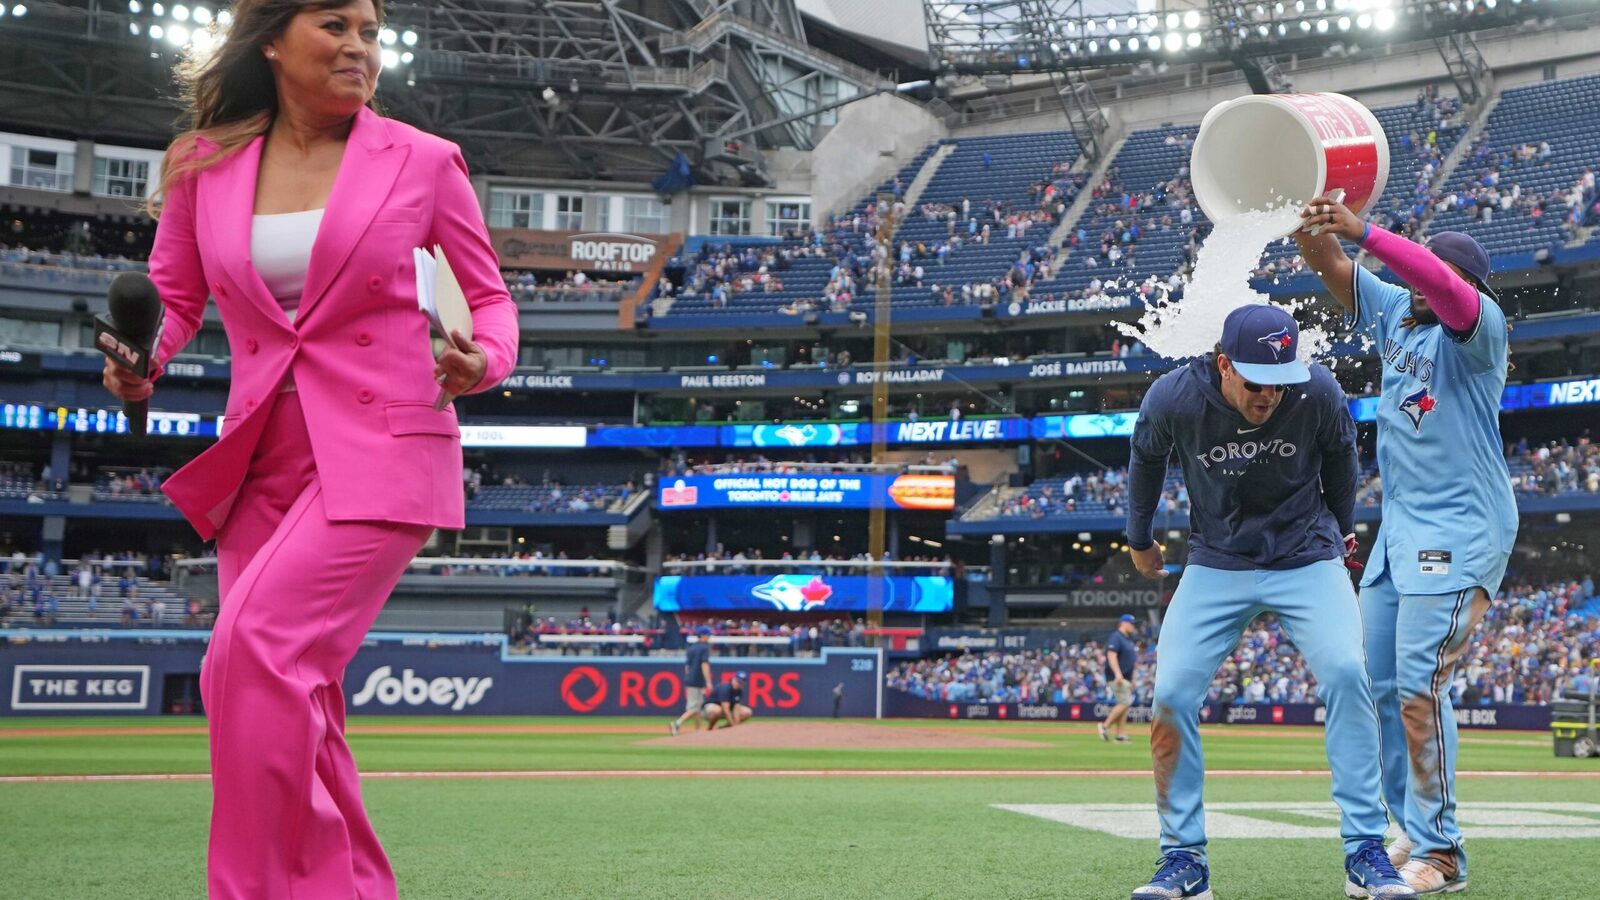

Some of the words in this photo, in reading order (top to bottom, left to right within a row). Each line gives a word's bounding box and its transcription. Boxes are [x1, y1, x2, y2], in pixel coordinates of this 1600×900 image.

[571, 241, 655, 262] ROOFTOP
[594, 261, 632, 271] PATIO
[1025, 300, 1066, 314] JACKIE
[99, 332, 139, 364] SN
[167, 363, 204, 376] STIEB
[856, 372, 880, 384] ROY
[883, 369, 944, 382] HALLADAY
[1029, 361, 1061, 377] JOSÉ
[1066, 360, 1126, 374] BAUTISTA
[526, 375, 573, 388] GILLICK
[681, 376, 710, 387] PAUL
[712, 374, 765, 387] BEESTON
[897, 422, 948, 442] NEXT
[949, 419, 1004, 440] LEVEL
[1196, 439, 1297, 469] TORONTO
[714, 479, 761, 490] OFFICIAL
[763, 478, 788, 490] HOT
[790, 478, 818, 490] DOG
[819, 478, 836, 490] OF
[838, 479, 861, 490] THE
[727, 491, 779, 503] TORONTO
[790, 491, 816, 503] BLUE
[816, 491, 844, 503] JAYS
[1071, 590, 1158, 606] TORONTO
[1004, 636, 1026, 648] BET
[29, 679, 78, 696] THE
[86, 679, 134, 696] KEG
[352, 665, 493, 711] Sobeys
[619, 671, 800, 707] RORS
[1471, 709, 1497, 725] BOX
